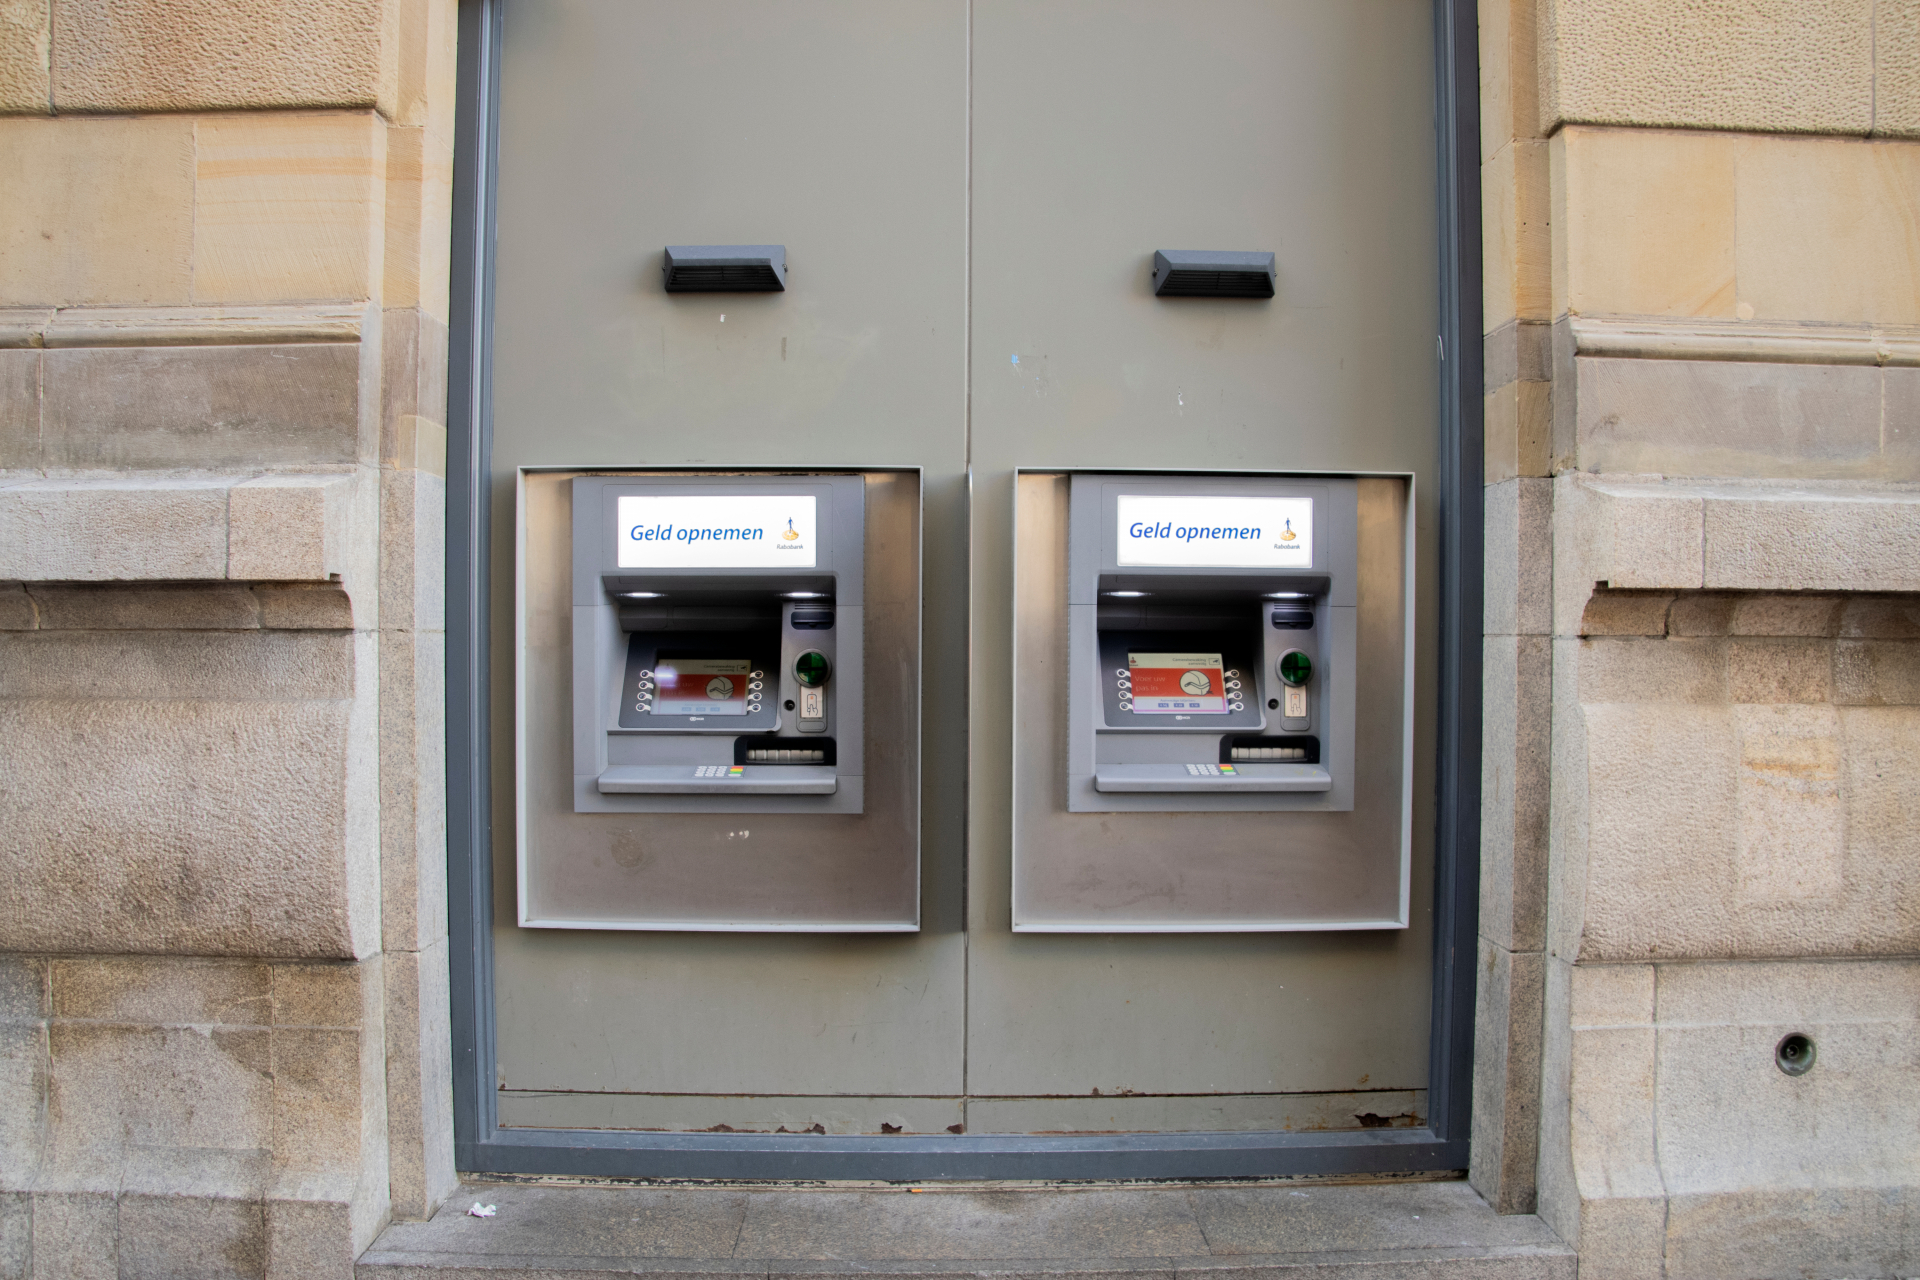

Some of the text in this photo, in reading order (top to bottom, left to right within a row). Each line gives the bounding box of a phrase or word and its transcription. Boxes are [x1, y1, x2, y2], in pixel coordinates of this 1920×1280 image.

[630, 524, 763, 545] Geld opnemen
[1129, 522, 1262, 543] Geld opnemen
